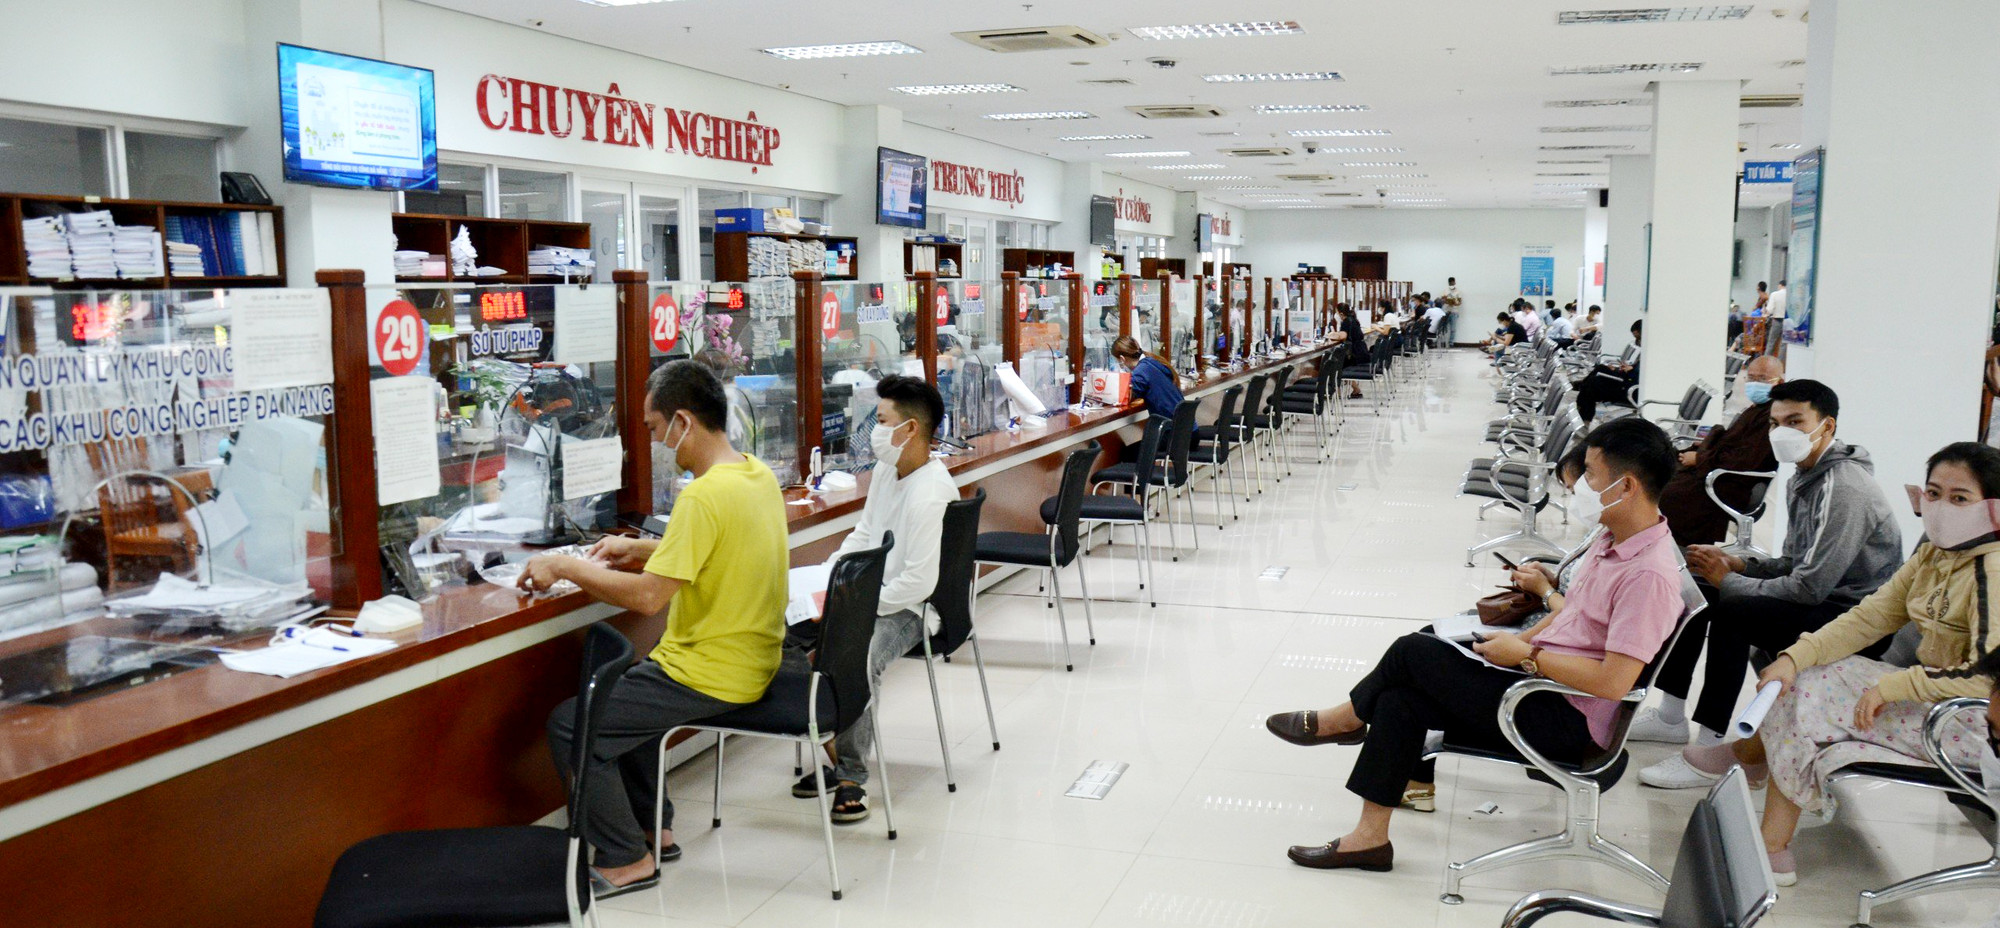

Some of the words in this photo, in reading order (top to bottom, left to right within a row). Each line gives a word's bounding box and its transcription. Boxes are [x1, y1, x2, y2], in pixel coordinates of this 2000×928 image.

[476, 74, 656, 150] CHUYÊN
[664, 107, 780, 175] NGHIỆP
[931, 159, 986, 197] TRUNG
[988, 168, 1024, 209] THỰC
[481, 291, 527, 320] 6011
[823, 301, 837, 330] 27
[936, 294, 949, 319] 26
[382, 315, 418, 361] 29
[473, 324, 489, 353] SỞ
[493, 328, 508, 351] TƯ
[511, 325, 541, 350] PHÁP
[654, 305, 676, 340] 28
[130, 351, 174, 379] KHU
[54, 411, 103, 442] KHU
[110, 401, 171, 437] CÔNG
[178, 392, 249, 429] NGHIỆP
[256, 388, 280, 420] ĐÀ
